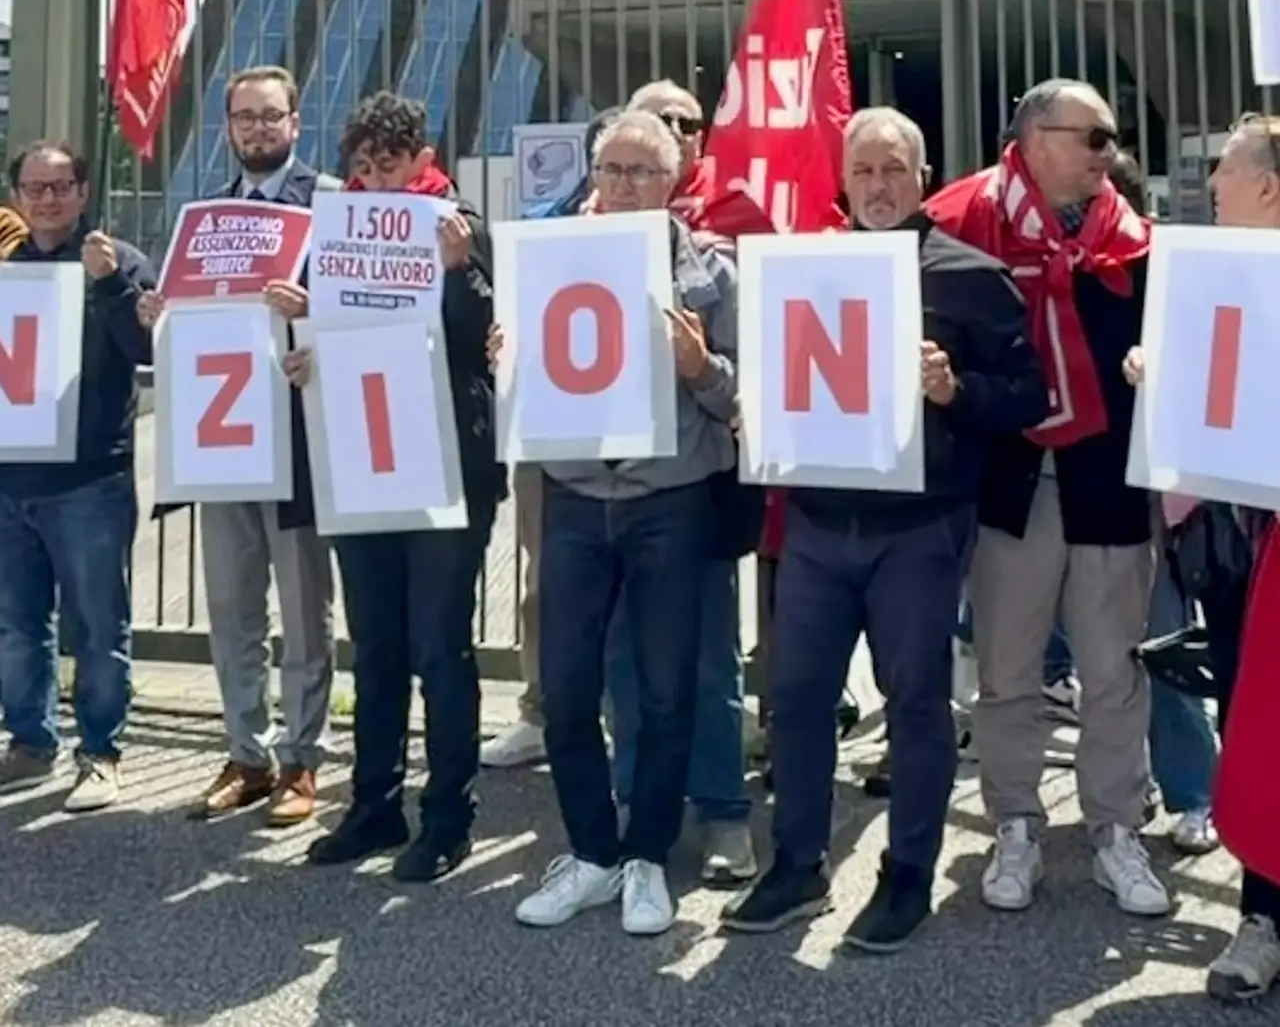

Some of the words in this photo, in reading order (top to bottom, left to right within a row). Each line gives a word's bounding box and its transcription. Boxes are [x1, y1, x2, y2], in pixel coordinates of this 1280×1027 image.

[346, 204, 412, 242] 1.500
[317, 254, 366, 280] SENZA
[371, 259, 435, 284] LAVORO
